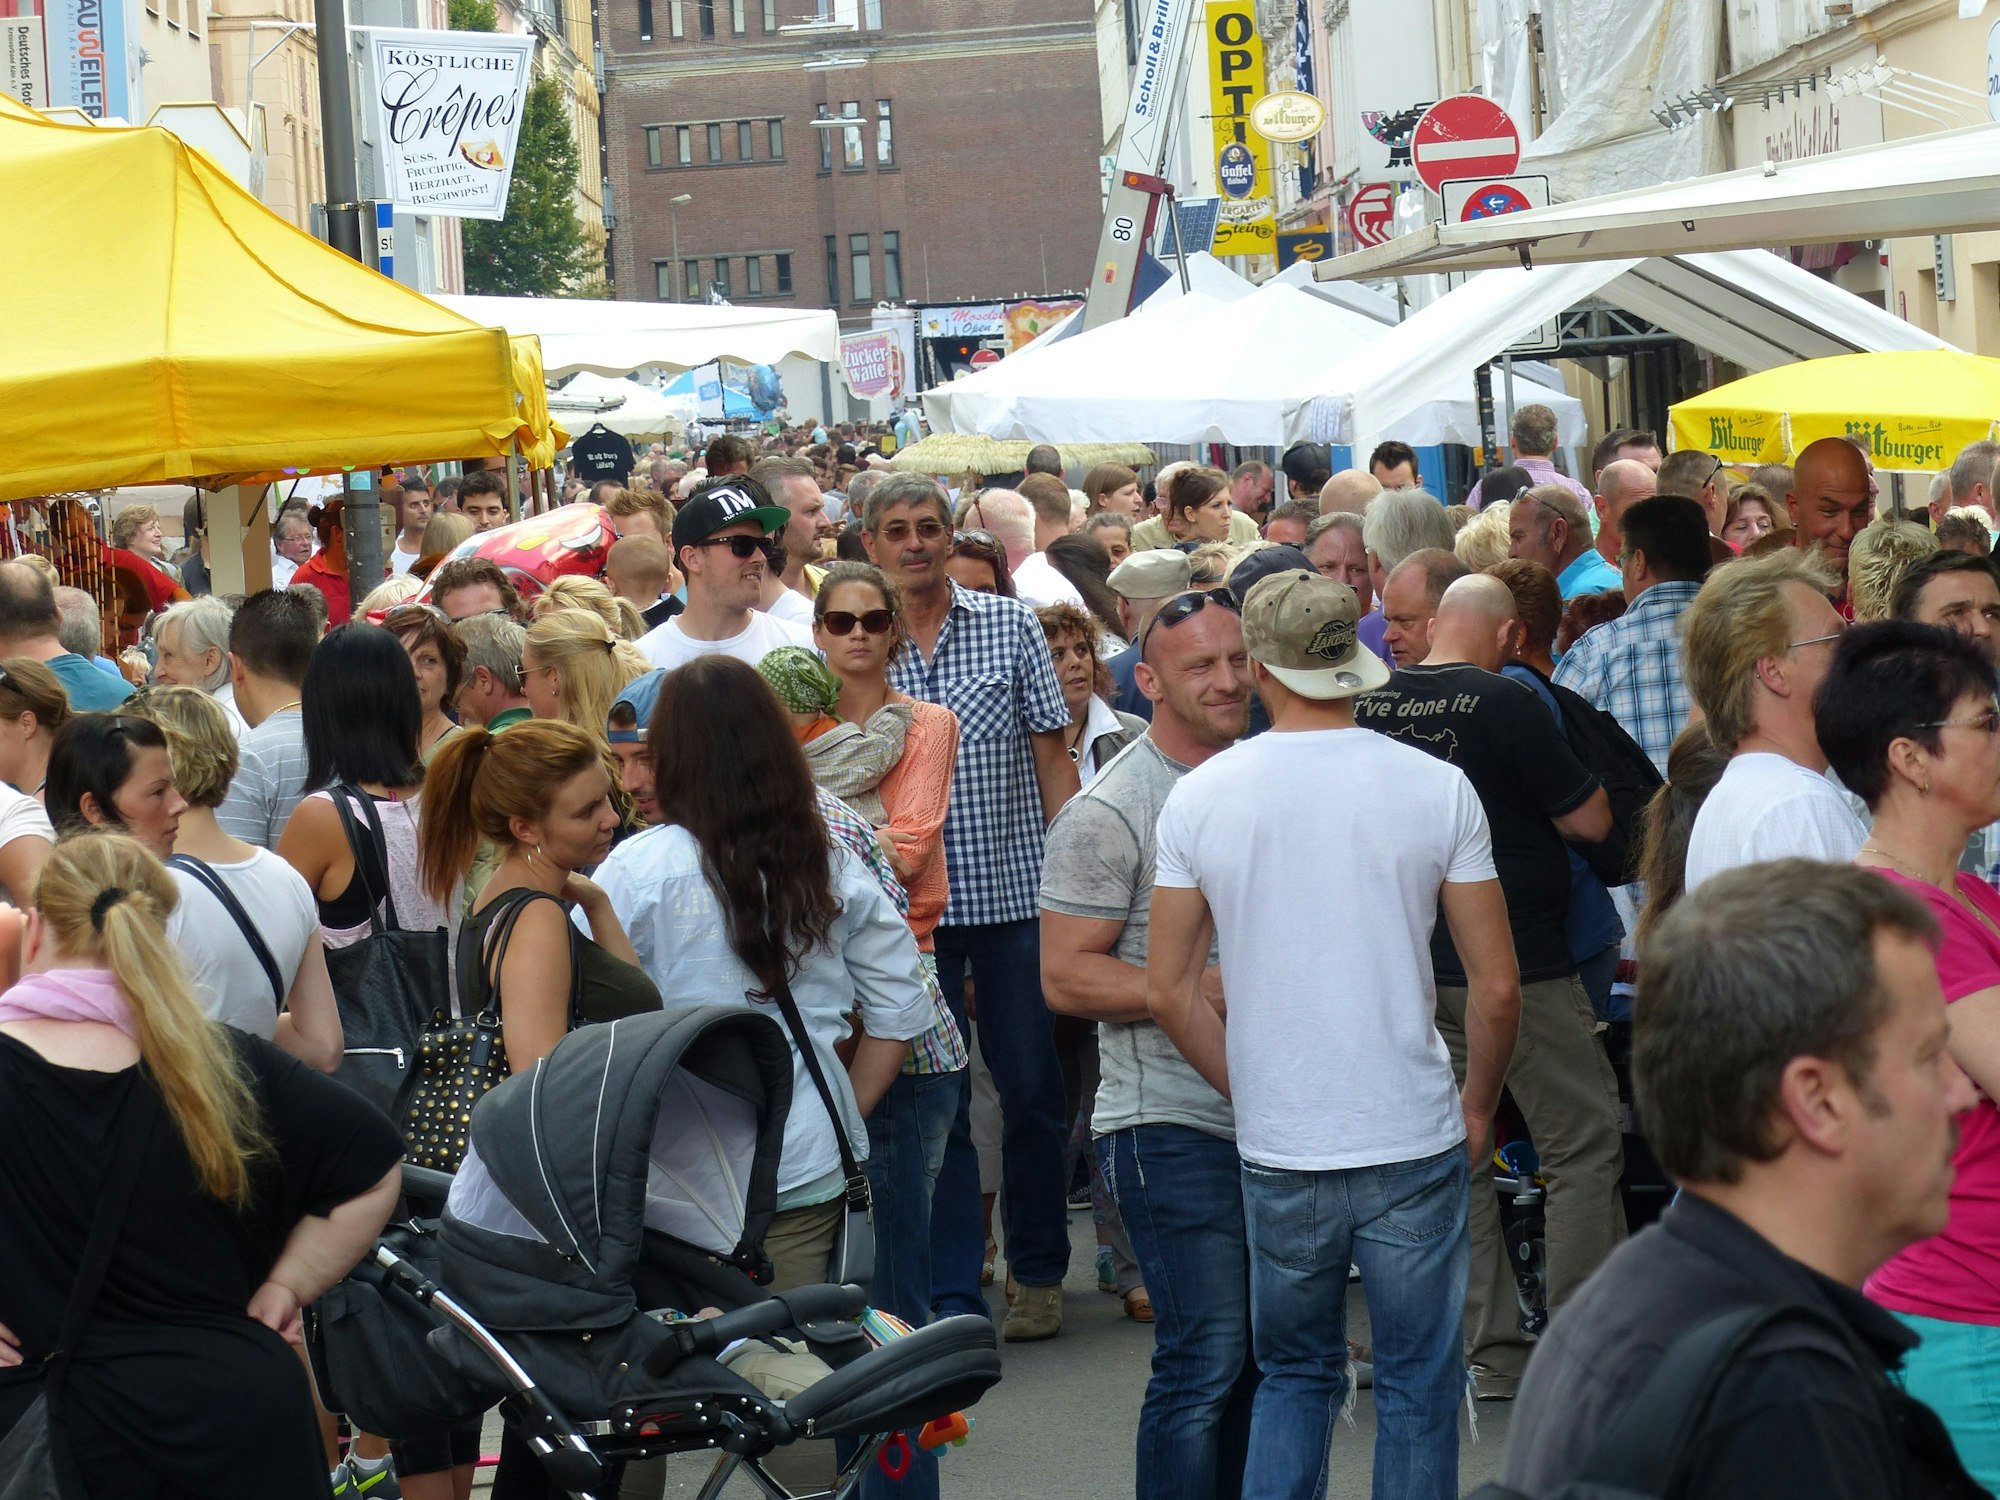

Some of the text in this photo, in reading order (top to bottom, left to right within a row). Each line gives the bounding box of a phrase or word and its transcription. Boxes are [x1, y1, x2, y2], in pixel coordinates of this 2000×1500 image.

[18, 26, 31, 79] Deutsches
[387, 50, 514, 71] KÖSTLICHE
[1135, 0, 1169, 116] Scholl & Brill
[1148, 22, 1172, 118] Dachdeckermeister GmbH
[70, 62, 80, 107] HEIZU
[1215, 13, 1258, 187] OPTI
[381, 67, 518, 158] Crêpes
[406, 162, 467, 178] FRUCHTIG,
[1221, 163, 1253, 177] Gaffel
[409, 174, 475, 192] HERZHAFT,
[412, 183, 489, 205] BESCHWIPST!
[1221, 198, 1268, 215] ERGARTEN
[1113, 217, 1133, 241] 80
[844, 346, 890, 368] Zucker-
[850, 363, 886, 383] watte
[1307, 628, 1356, 653] LAKERS
[1353, 693, 1480, 718] I've done it!
